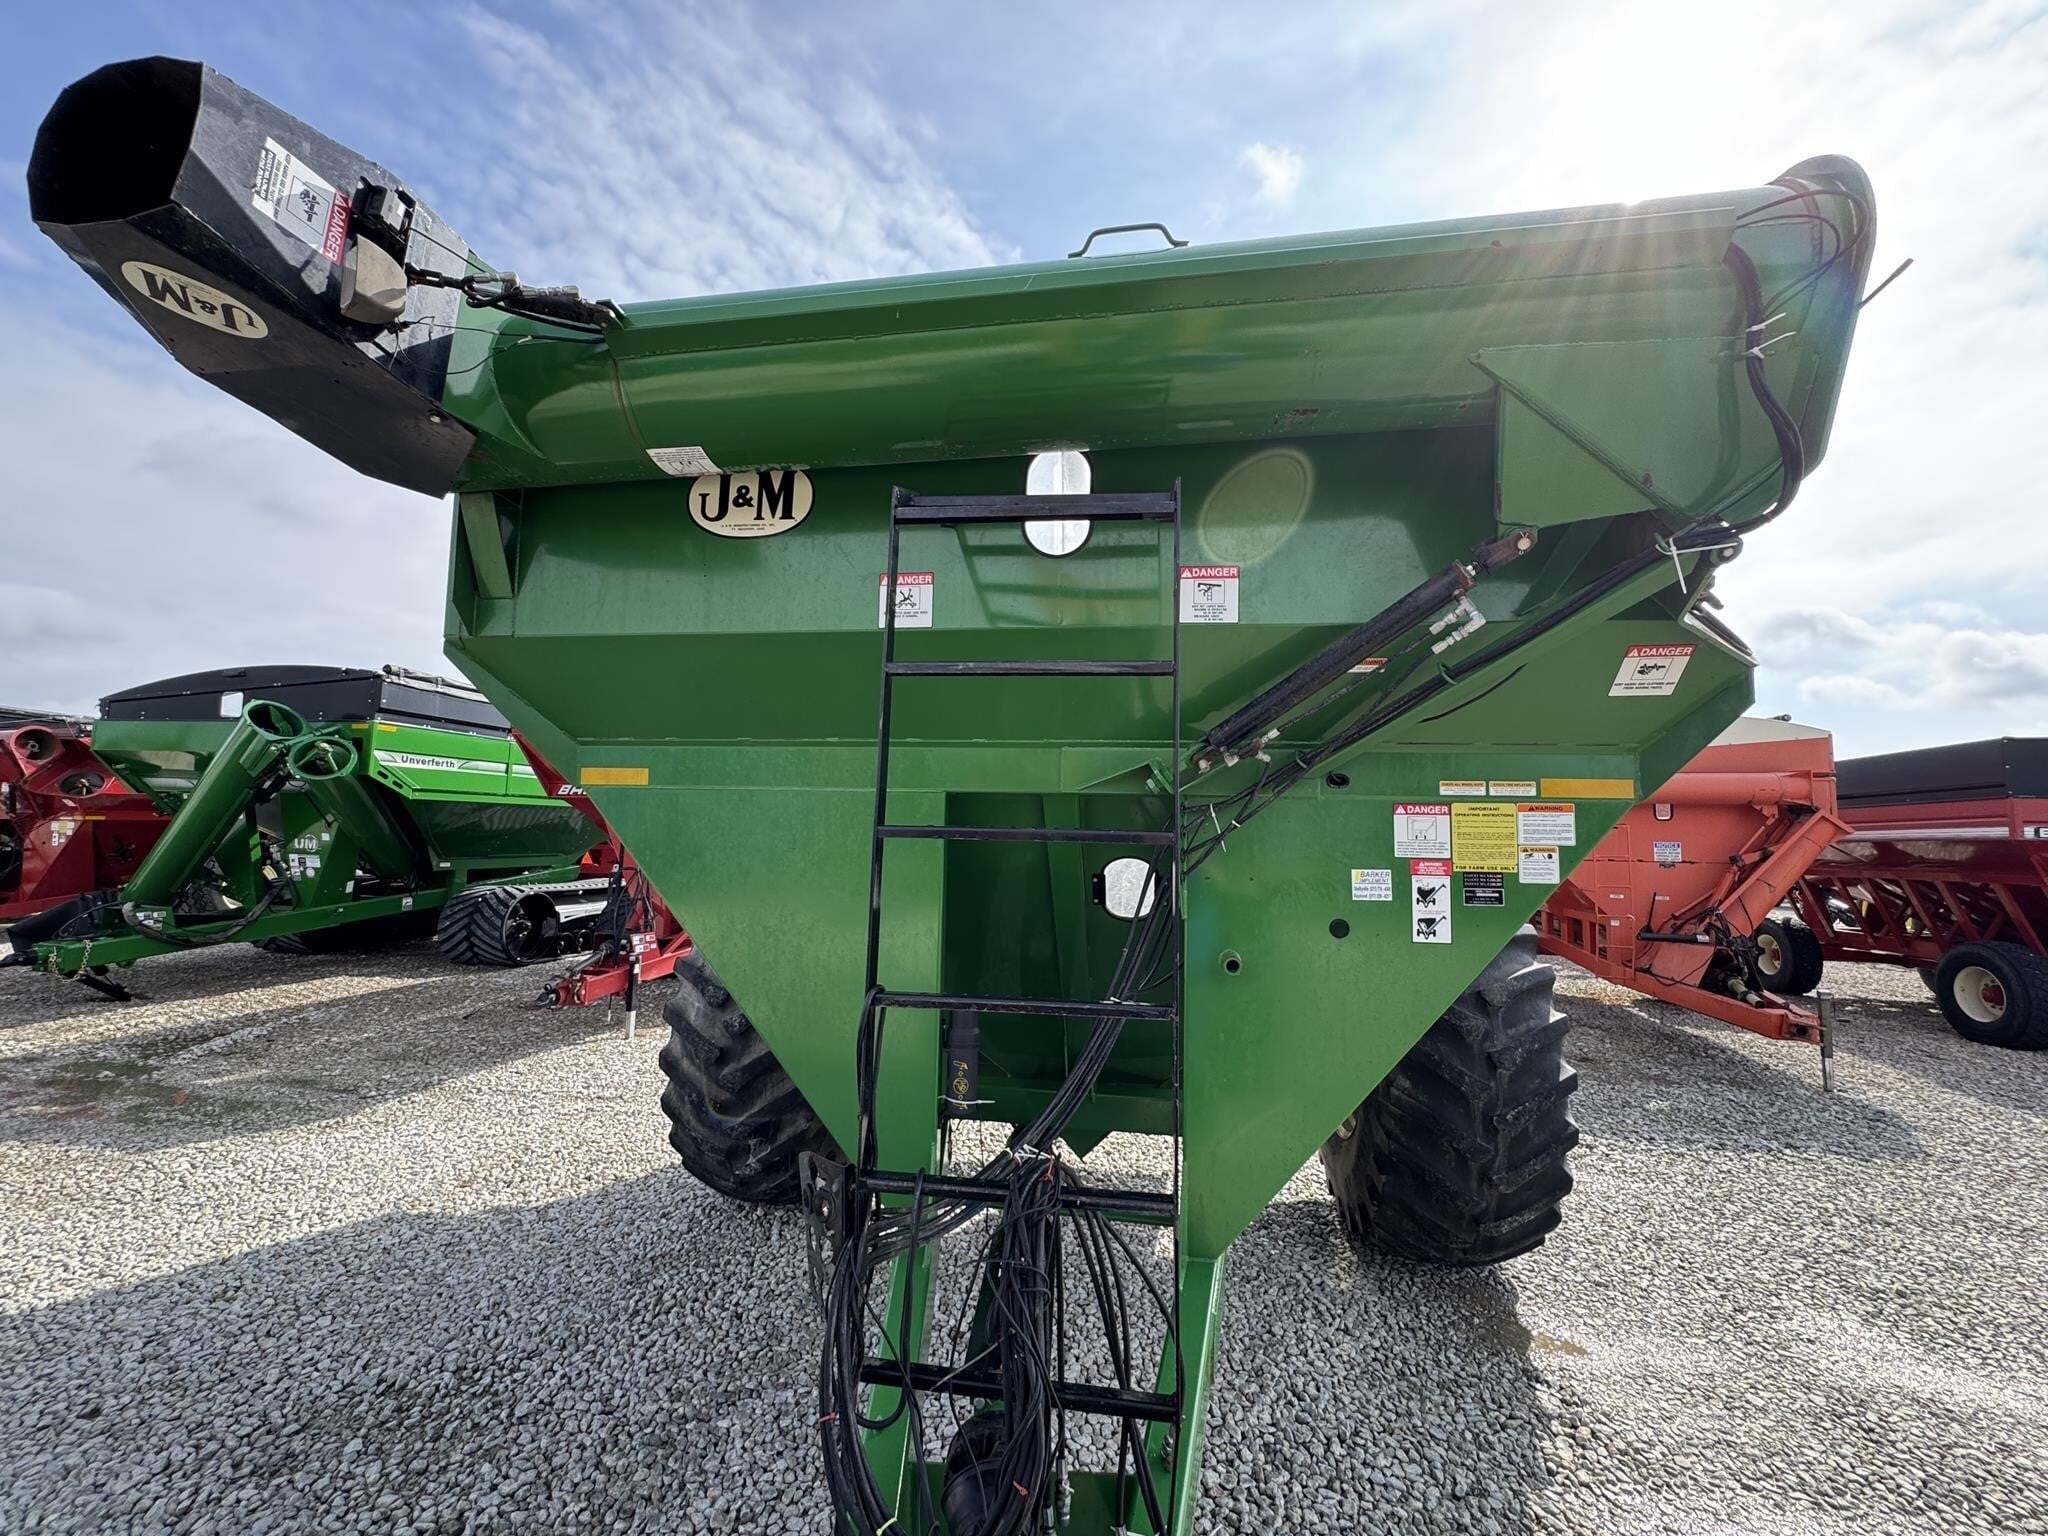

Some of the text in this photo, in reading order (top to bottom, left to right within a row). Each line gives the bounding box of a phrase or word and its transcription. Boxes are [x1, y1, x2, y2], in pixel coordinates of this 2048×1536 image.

[325, 206, 347, 261] DANGER
[137, 266, 258, 332] J&M
[698, 469, 798, 522] J&M
[1192, 567, 1238, 577] DANGER
[897, 575, 932, 585] ANGER
[1640, 647, 1693, 657] DANGER
[401, 755, 455, 769] Unverferth
[1407, 805, 1449, 814] DANGER
